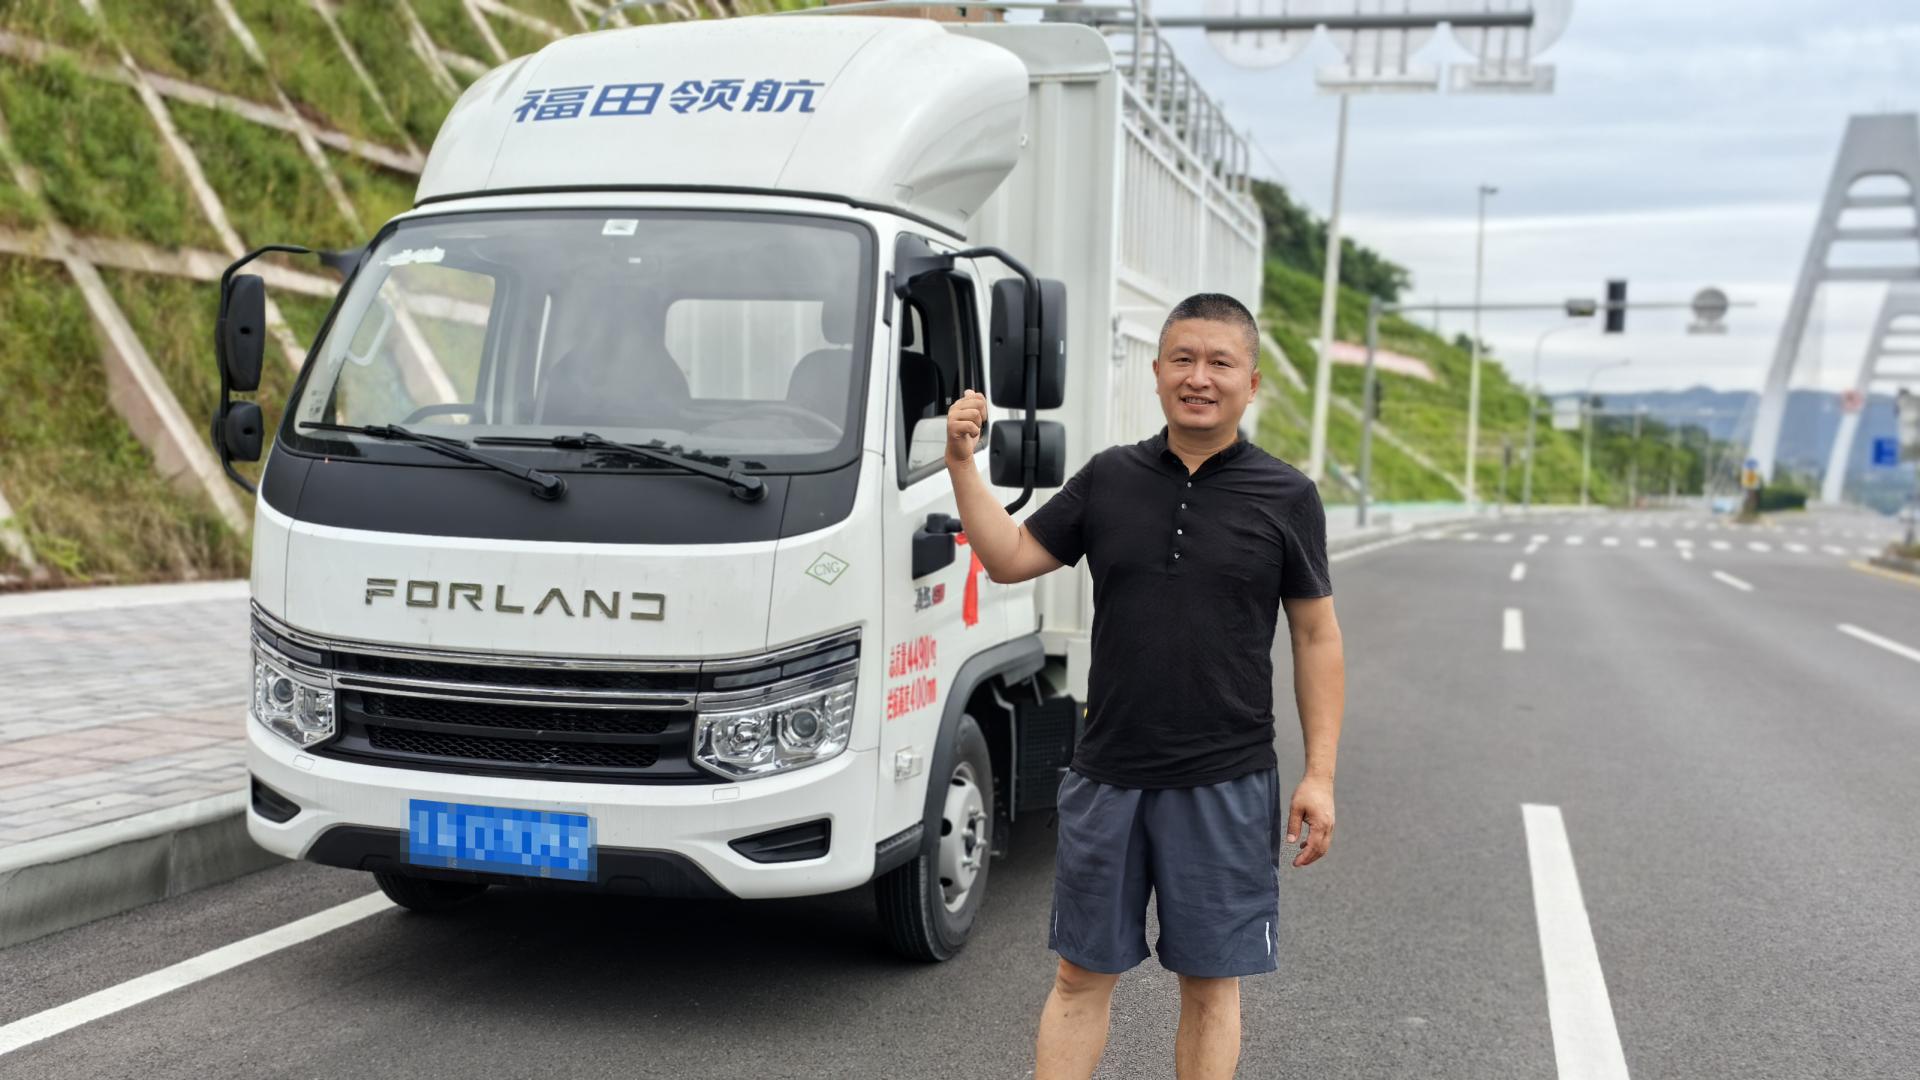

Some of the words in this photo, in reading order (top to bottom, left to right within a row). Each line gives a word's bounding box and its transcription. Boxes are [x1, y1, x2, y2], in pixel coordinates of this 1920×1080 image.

[513, 79, 825, 123] 福田领航
[814, 561, 841, 576] CNG
[366, 577, 667, 622] FORLAND
